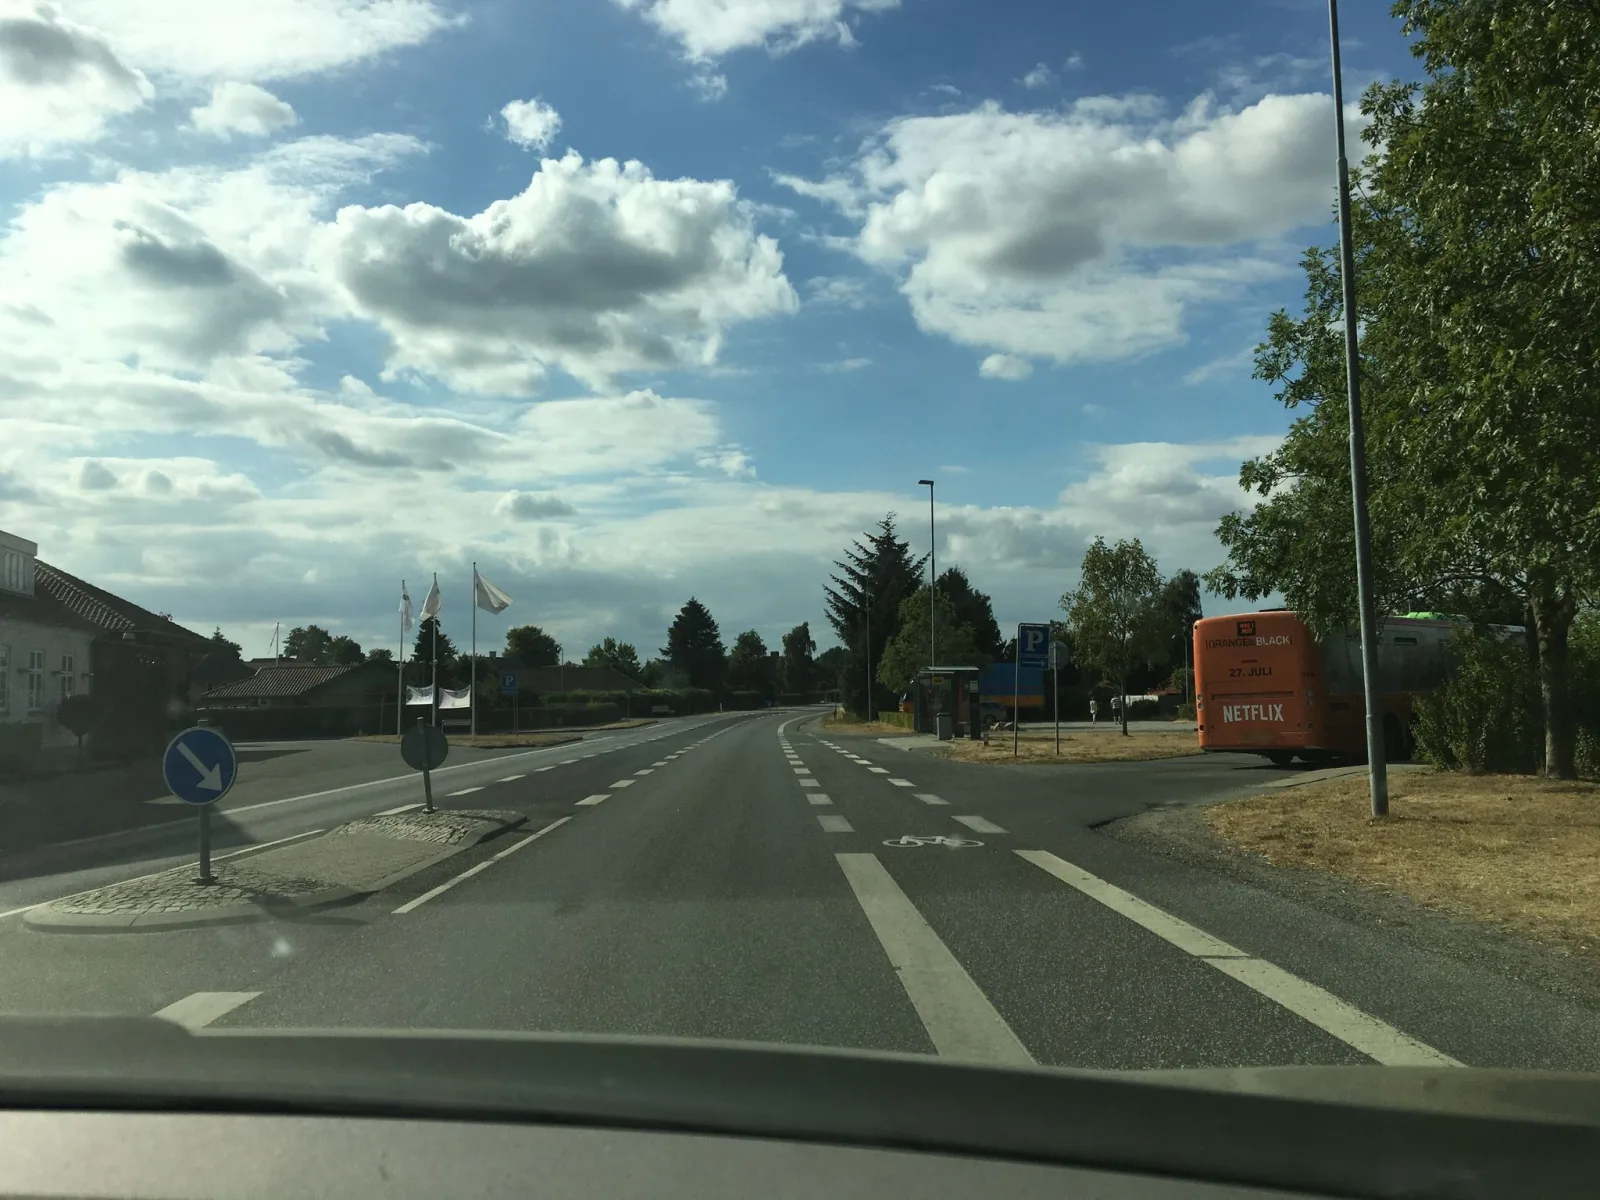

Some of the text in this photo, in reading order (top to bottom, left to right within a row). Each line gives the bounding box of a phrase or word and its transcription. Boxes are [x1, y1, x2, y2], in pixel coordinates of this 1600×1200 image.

[1025, 630, 1044, 652] P
[1256, 635, 1290, 646] BLACK
[1230, 667, 1272, 677] 27. JULI
[504, 675, 514, 687] P
[1223, 704, 1284, 723] NETFLIX
